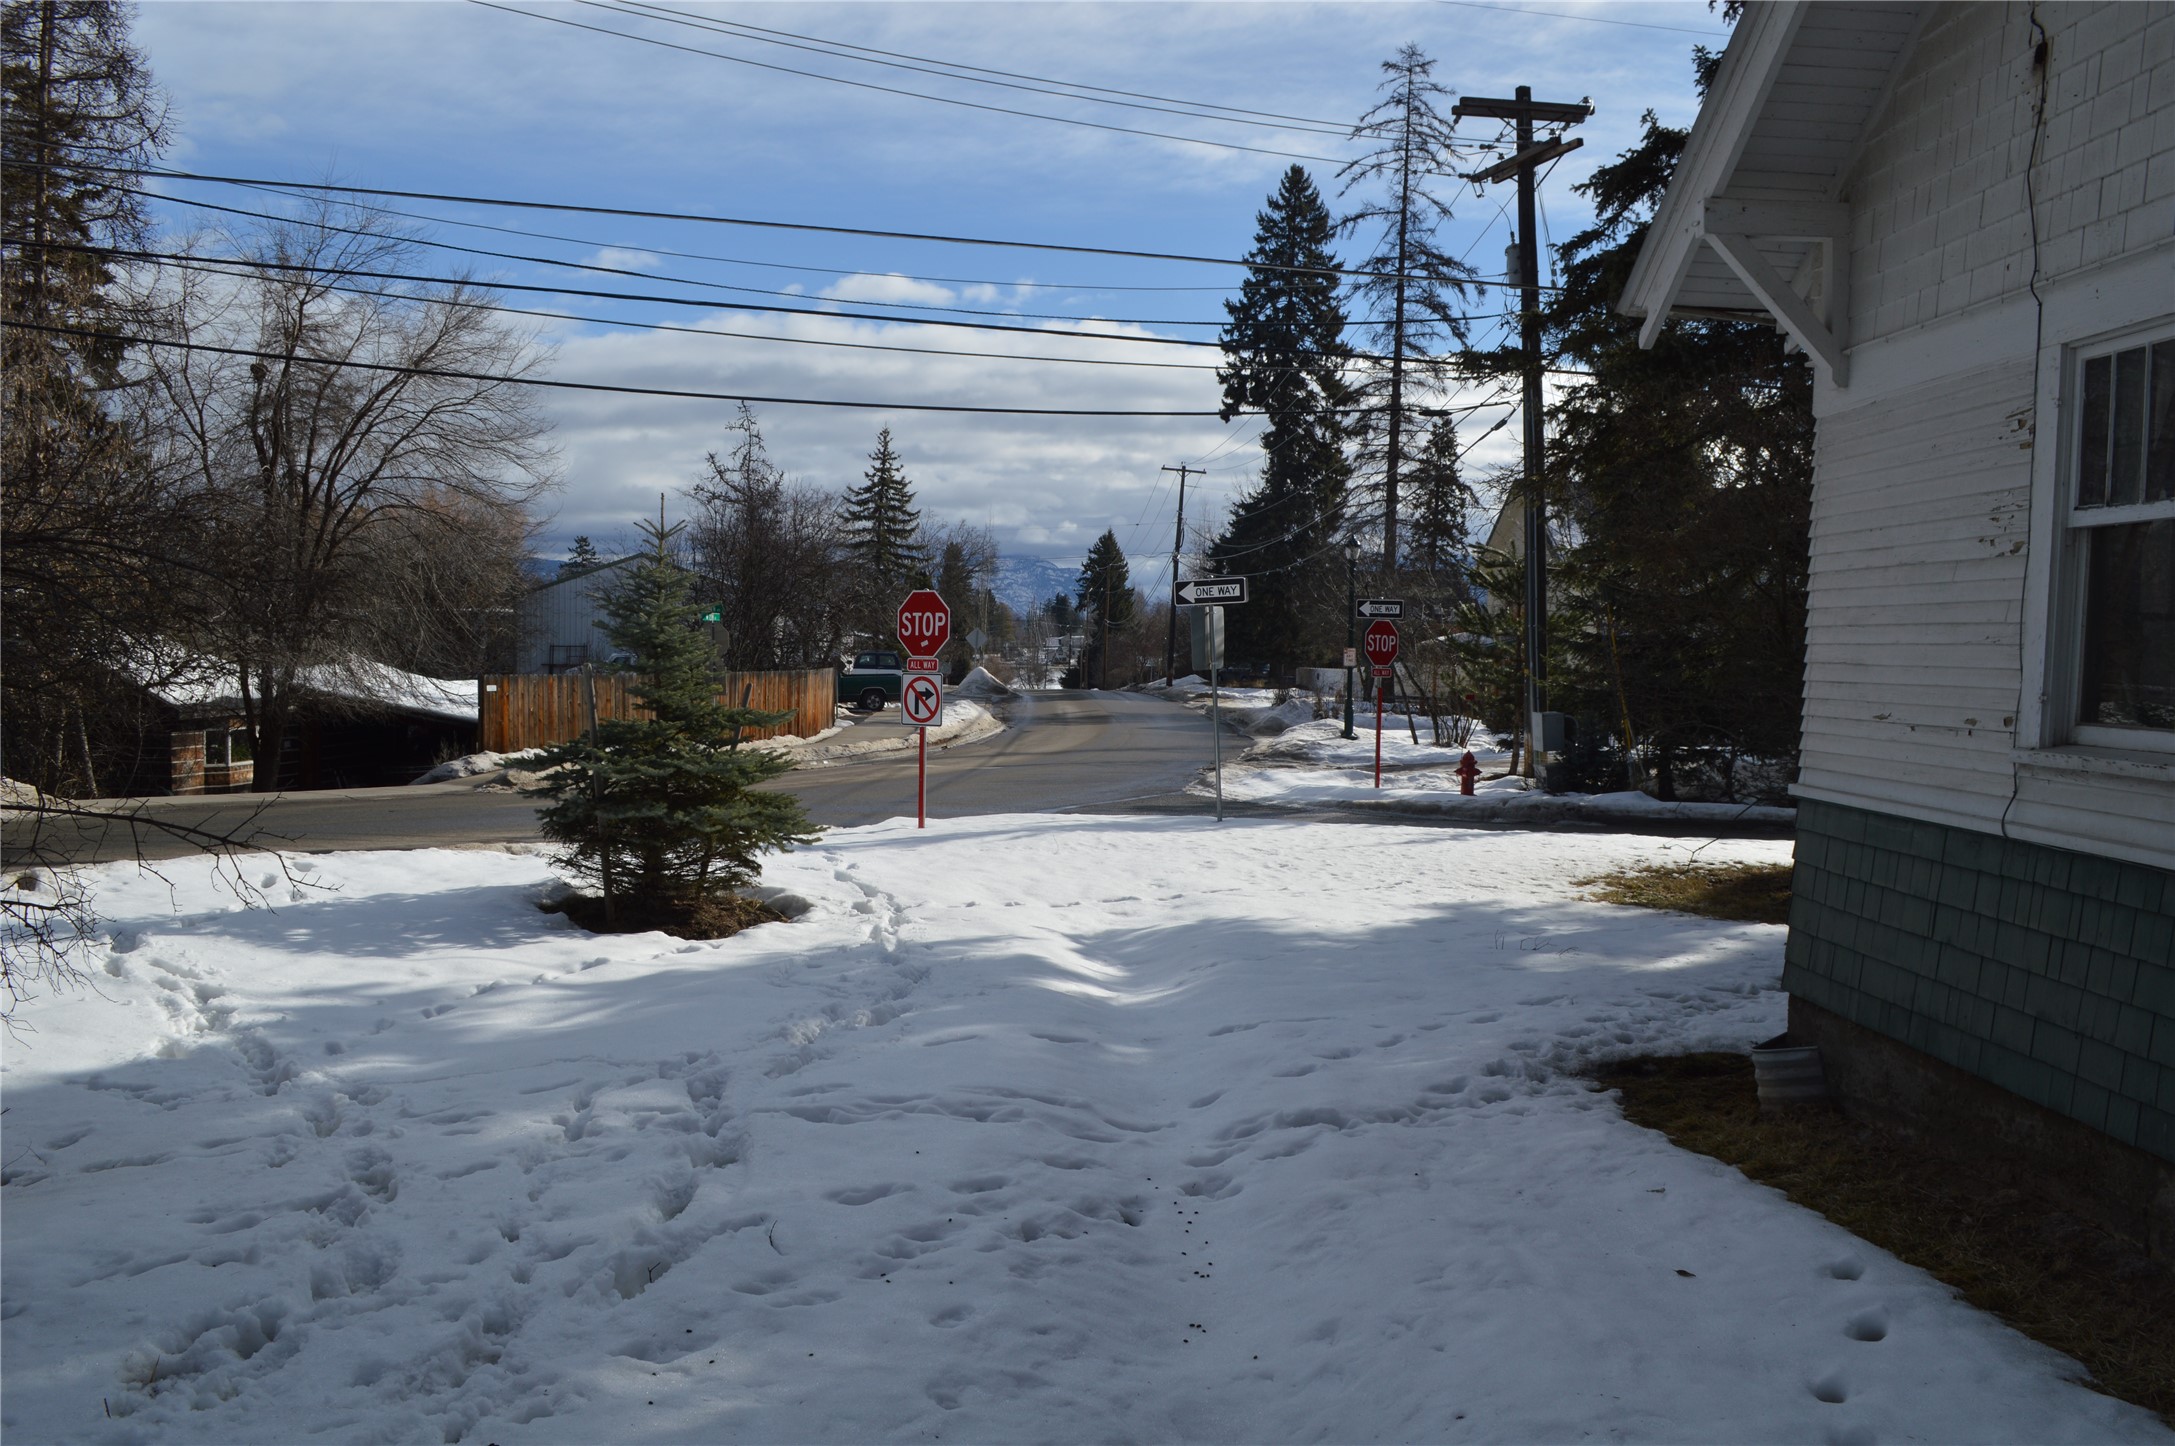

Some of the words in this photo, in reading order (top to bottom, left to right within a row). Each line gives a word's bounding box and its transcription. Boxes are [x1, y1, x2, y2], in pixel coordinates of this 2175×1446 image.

[1195, 587, 1215, 597] ONE
[1217, 585, 1237, 596] WAY
[1369, 605, 1383, 613] ONE
[1384, 605, 1398, 613] WAY
[901, 612, 946, 637] STOP
[1367, 634, 1397, 652] STOP
[909, 661, 921, 670] ALL
[923, 661, 936, 670] WAY
